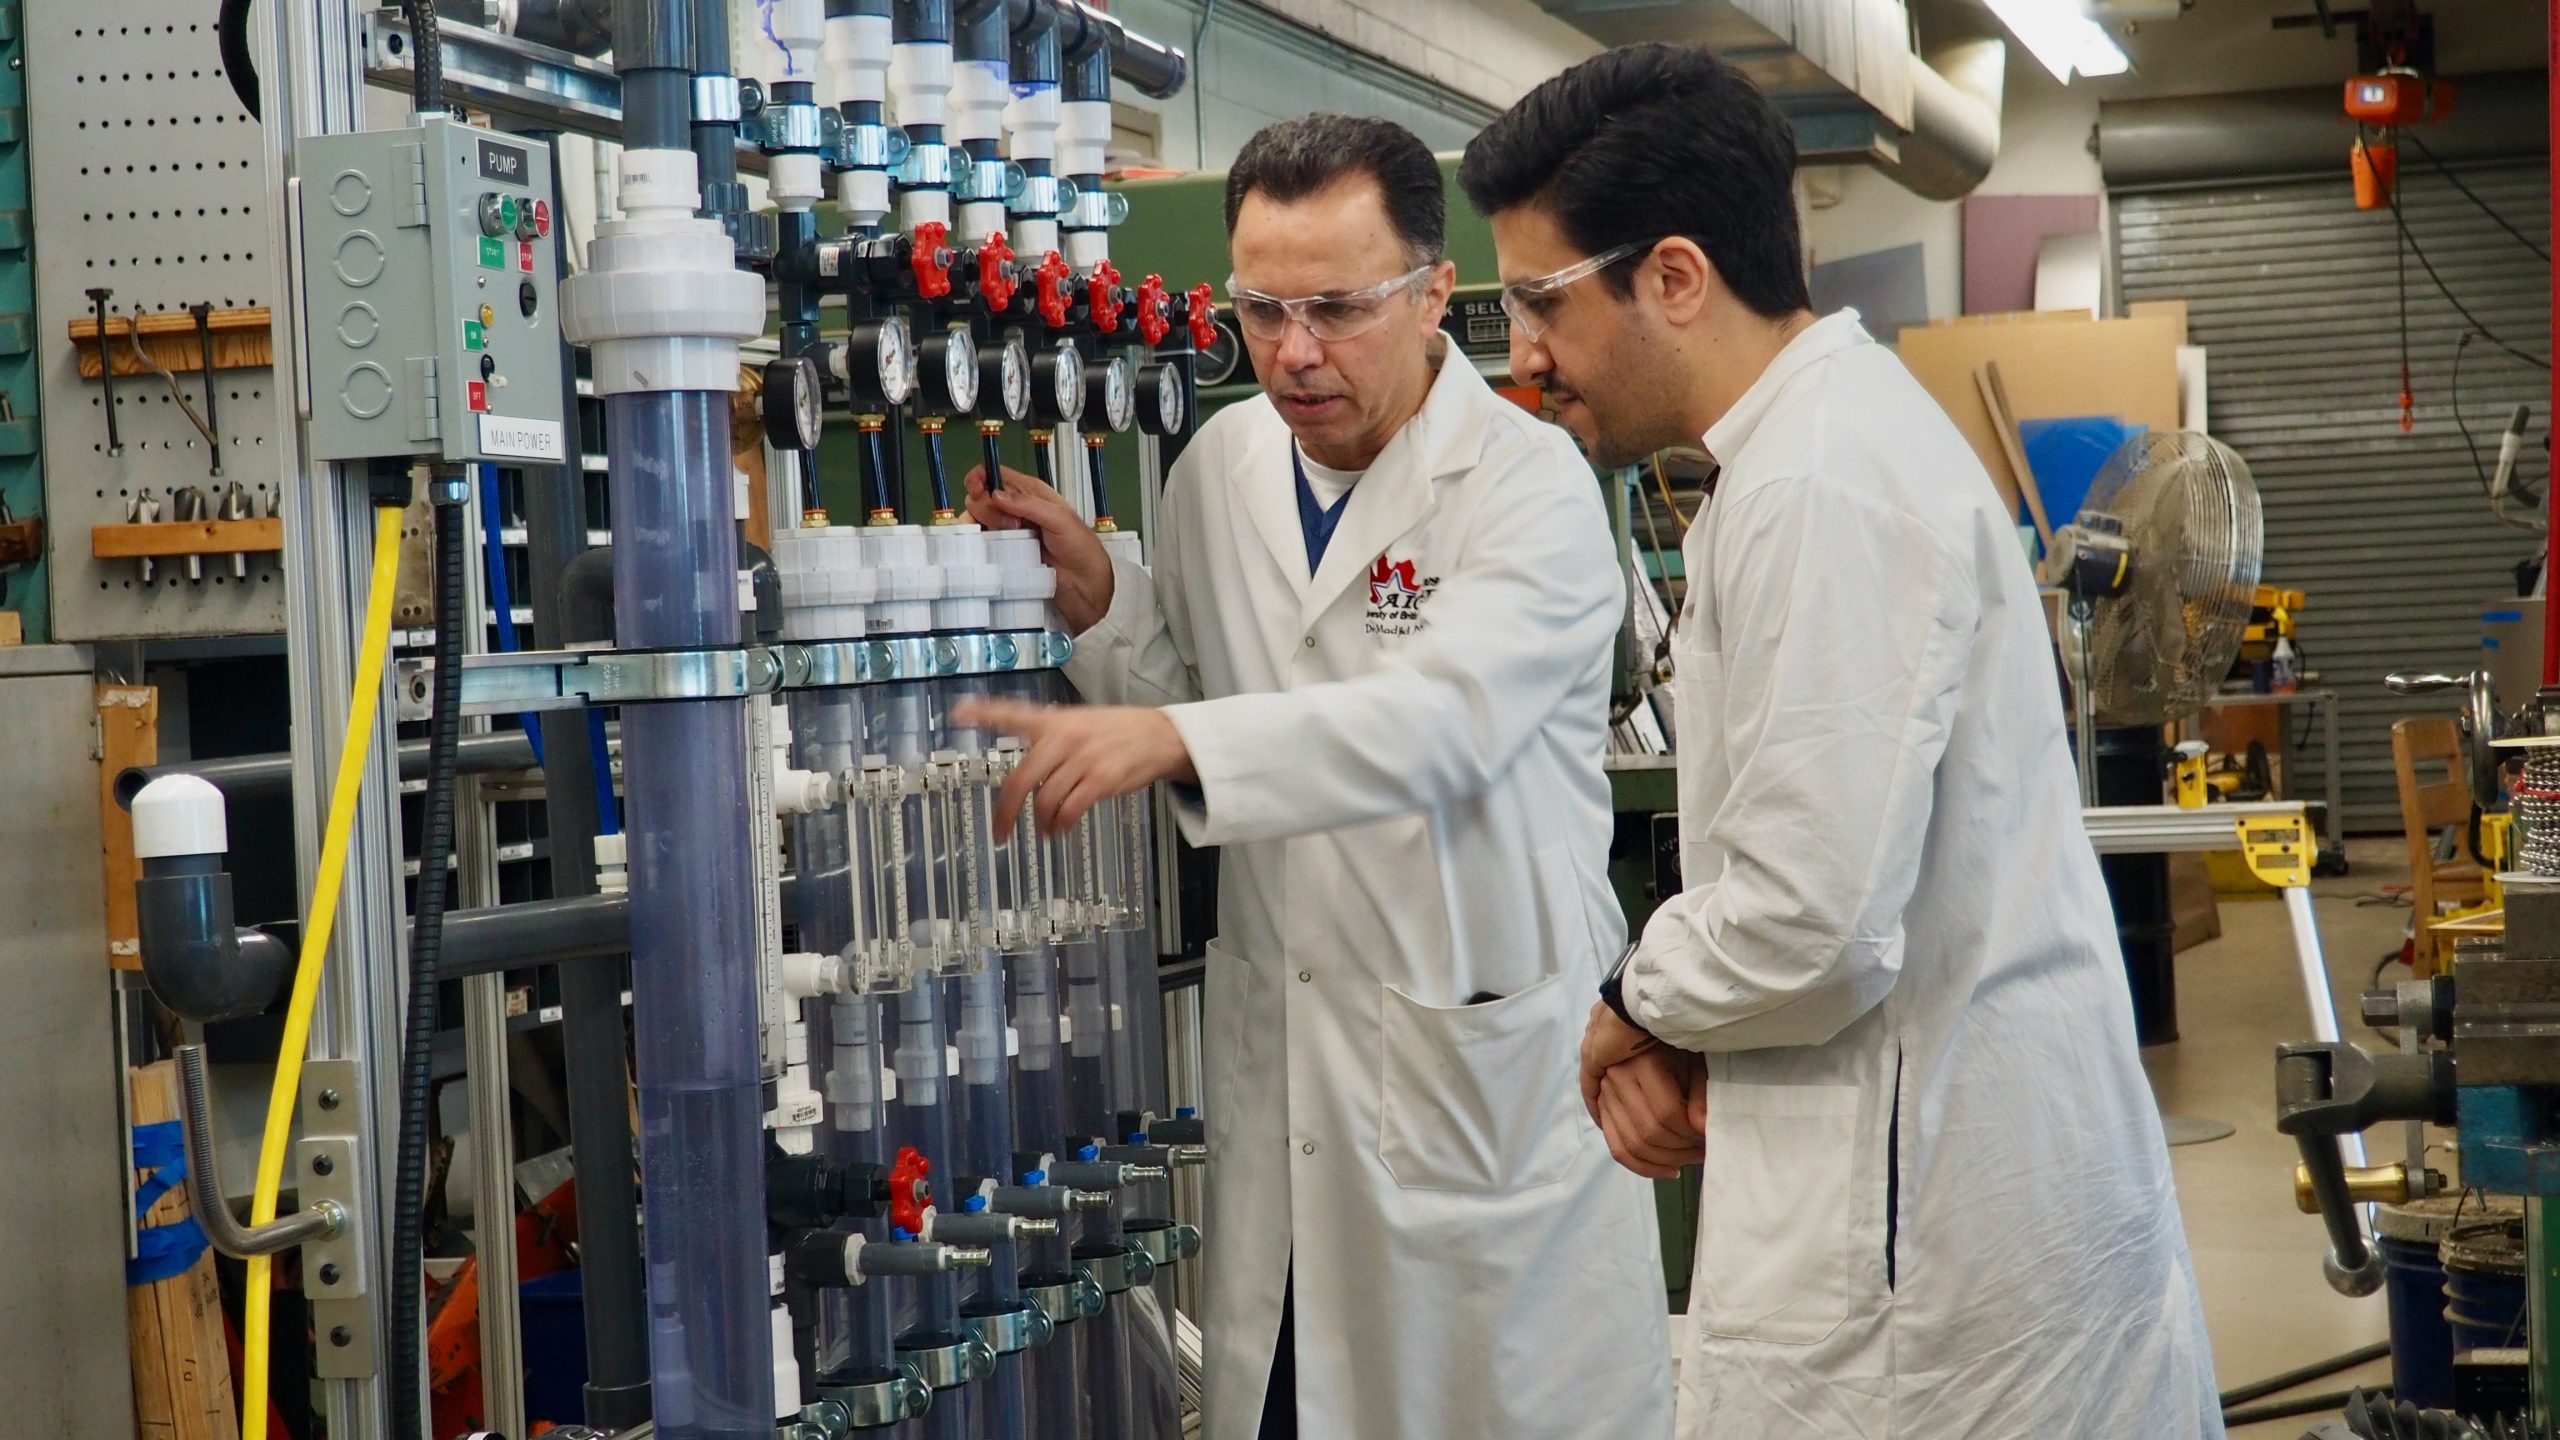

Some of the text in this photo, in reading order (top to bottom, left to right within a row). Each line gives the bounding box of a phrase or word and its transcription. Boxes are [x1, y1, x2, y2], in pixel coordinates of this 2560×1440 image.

[489, 152, 517, 175] PUMP
[521, 253, 532, 262] STOP
[1464, 302, 1501, 316] SEL
[473, 392, 481, 401] OFF
[491, 429, 551, 451] MAIN POWER
[1389, 611, 1399, 620] of
